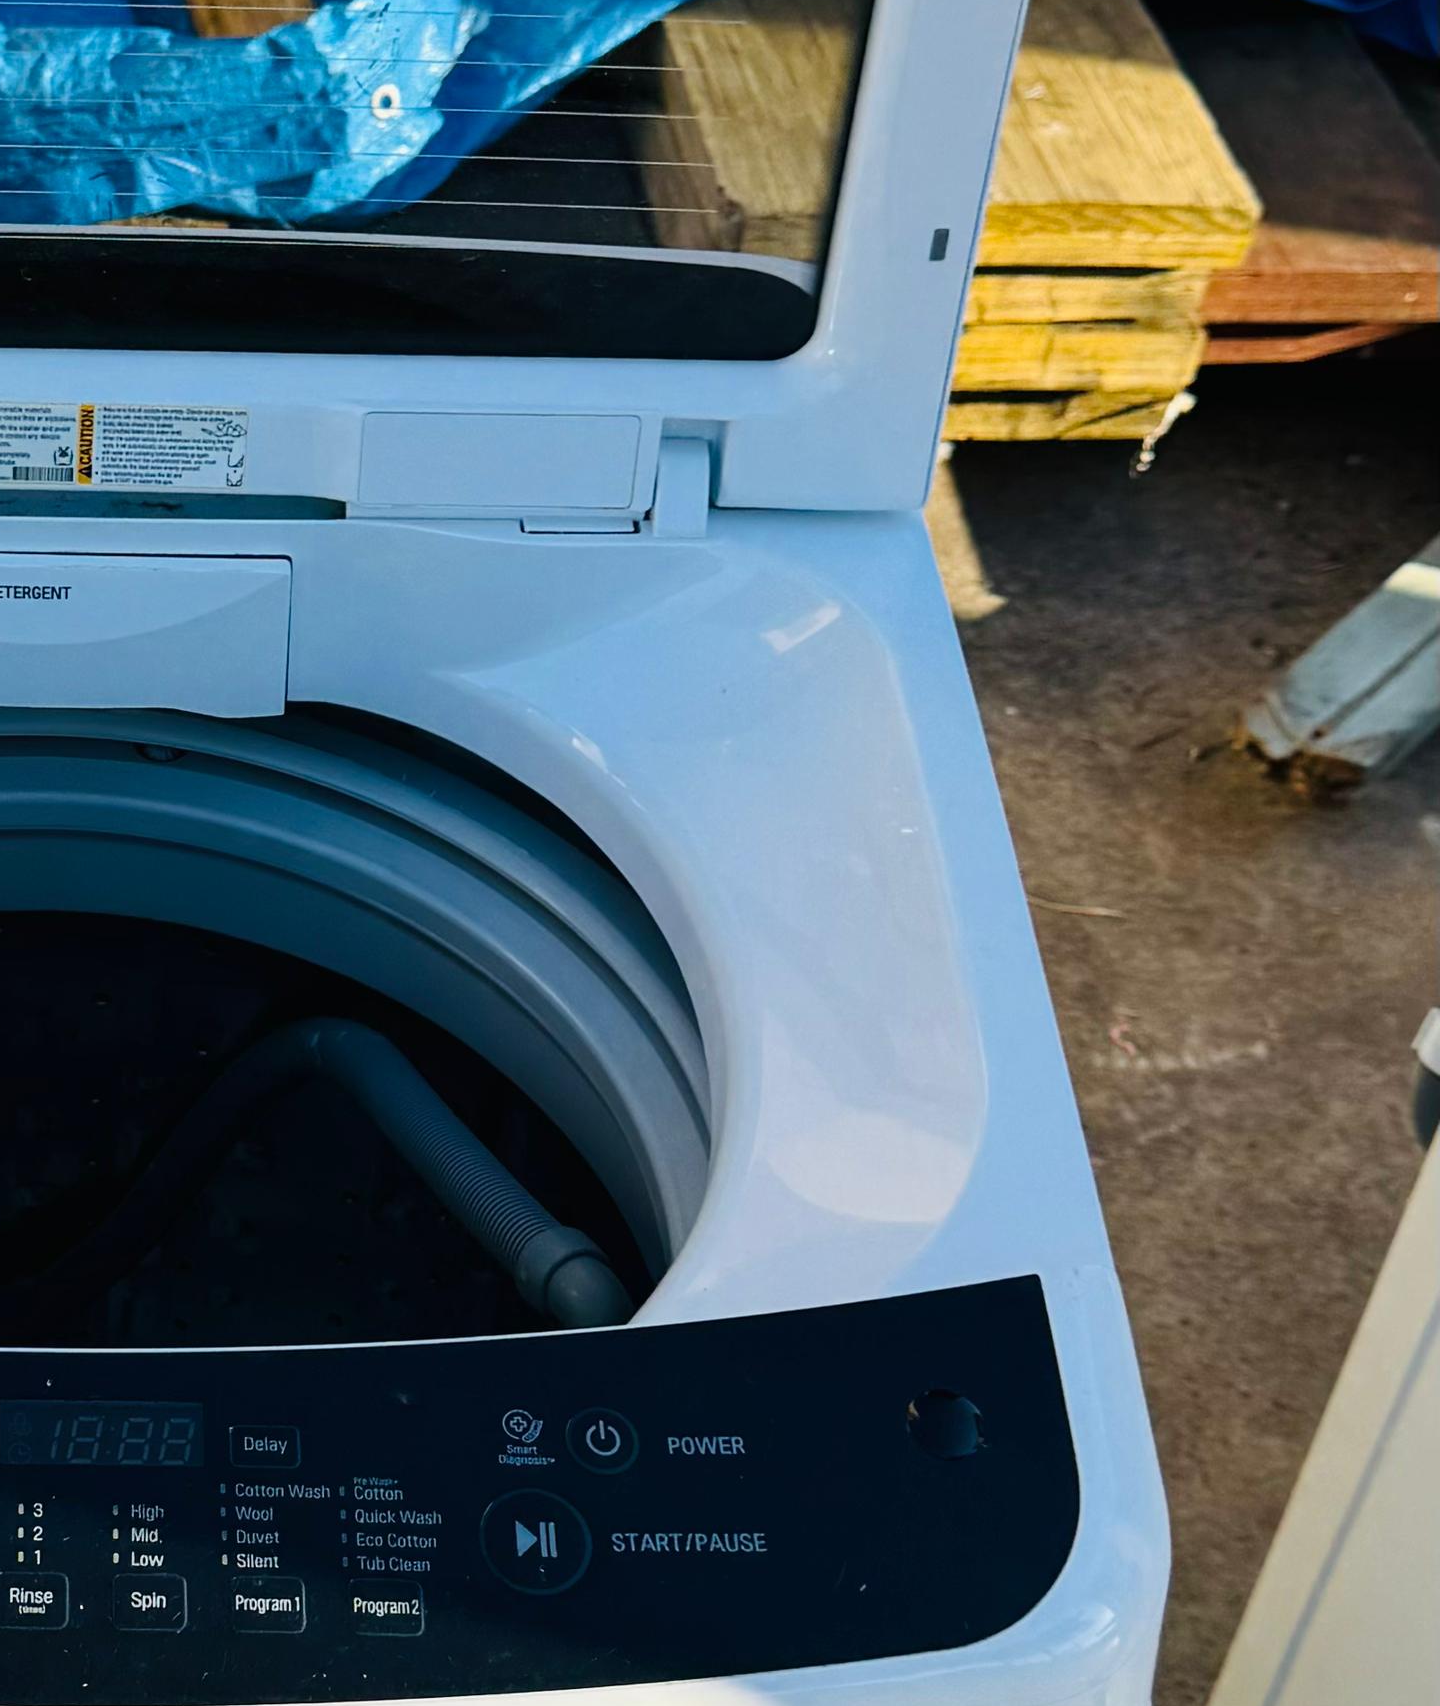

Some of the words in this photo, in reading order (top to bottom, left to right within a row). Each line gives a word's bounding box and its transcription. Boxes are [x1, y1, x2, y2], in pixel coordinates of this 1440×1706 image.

[78, 407, 94, 465] CAUTION
[243, 1436, 288, 1455] Delay
[506, 1444, 538, 1456] Smart
[667, 1436, 746, 1455] POWER
[235, 1483, 285, 1498] Cotton
[288, 1484, 331, 1499] Wash
[353, 1486, 404, 1501] Cotton
[32, 1502, 44, 1518] 3
[131, 1503, 165, 1522] High
[235, 1505, 274, 1522] Wool
[354, 1508, 396, 1525] Quick
[399, 1510, 443, 1525] Wash
[32, 1525, 44, 1542] 2
[236, 1529, 280, 1544] Duvet
[356, 1532, 383, 1548] Eco
[387, 1532, 437, 1549] Cotton
[611, 1532, 768, 1553] START/PAUSE
[34, 1549, 42, 1565] 1
[131, 1551, 164, 1567] Low
[236, 1553, 280, 1569] Silent
[356, 1555, 385, 1572] Tub
[389, 1556, 431, 1572] Clean
[9, 1587, 54, 1604] Rinse
[130, 1591, 167, 1611] Spin
